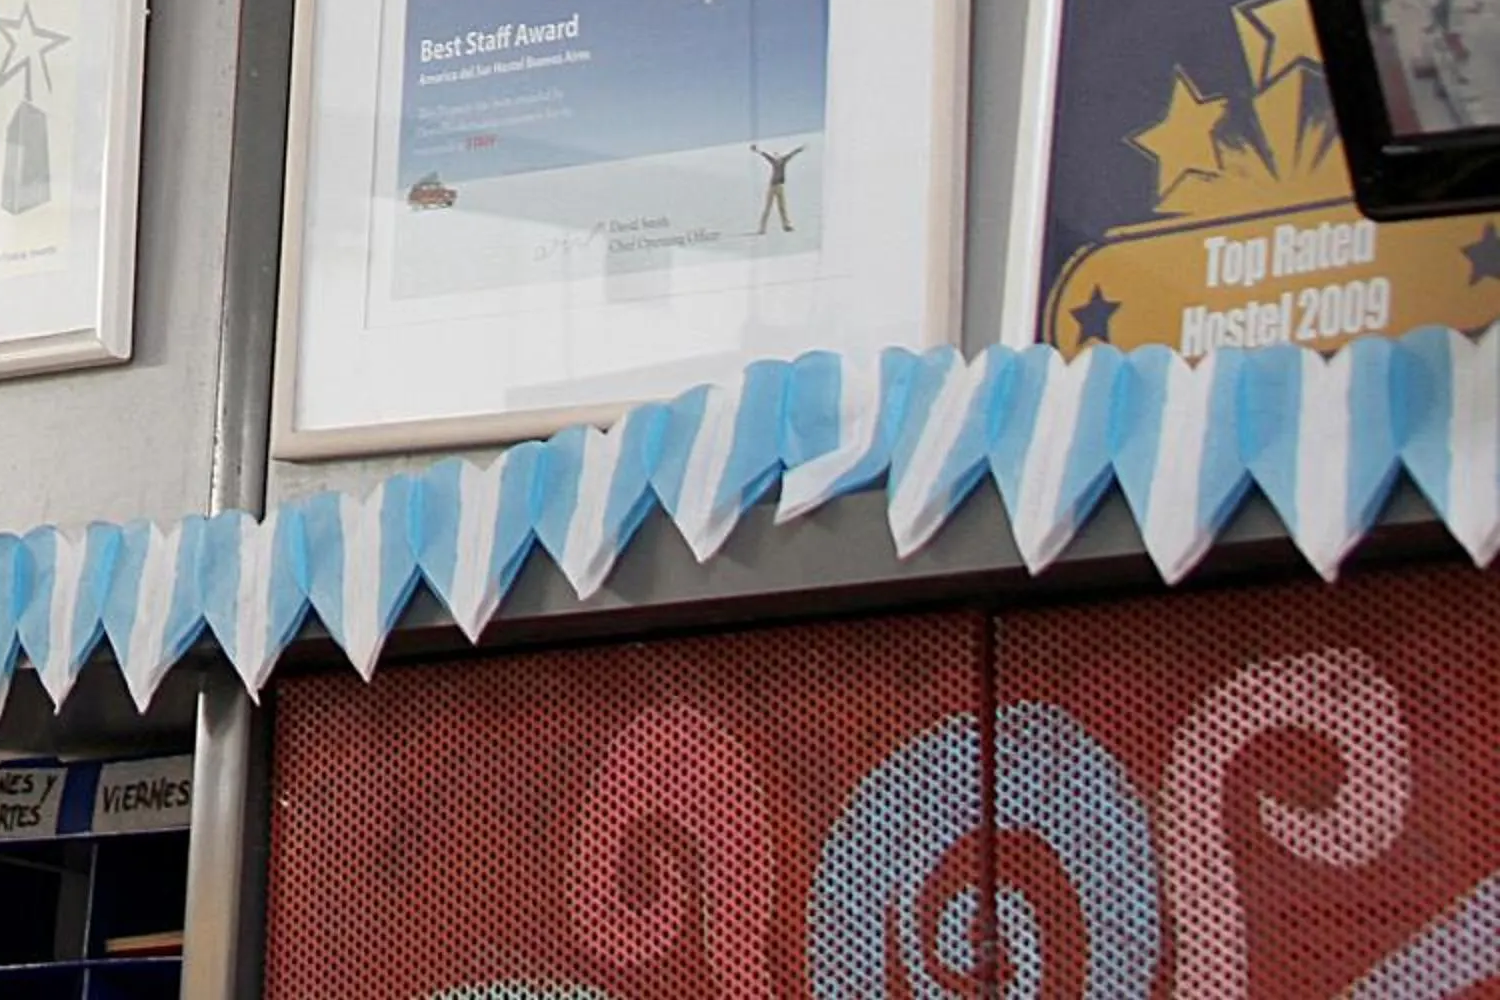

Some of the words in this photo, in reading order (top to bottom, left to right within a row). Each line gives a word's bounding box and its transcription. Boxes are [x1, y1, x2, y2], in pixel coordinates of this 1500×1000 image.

[420, 35, 463, 63] Best
[464, 23, 514, 56] Staff
[514, 12, 580, 47] Award
[1203, 235, 1269, 289] Top
[1271, 219, 1377, 278] Rated
[1181, 291, 1295, 357] Hostel
[1293, 277, 1391, 340] 2009
